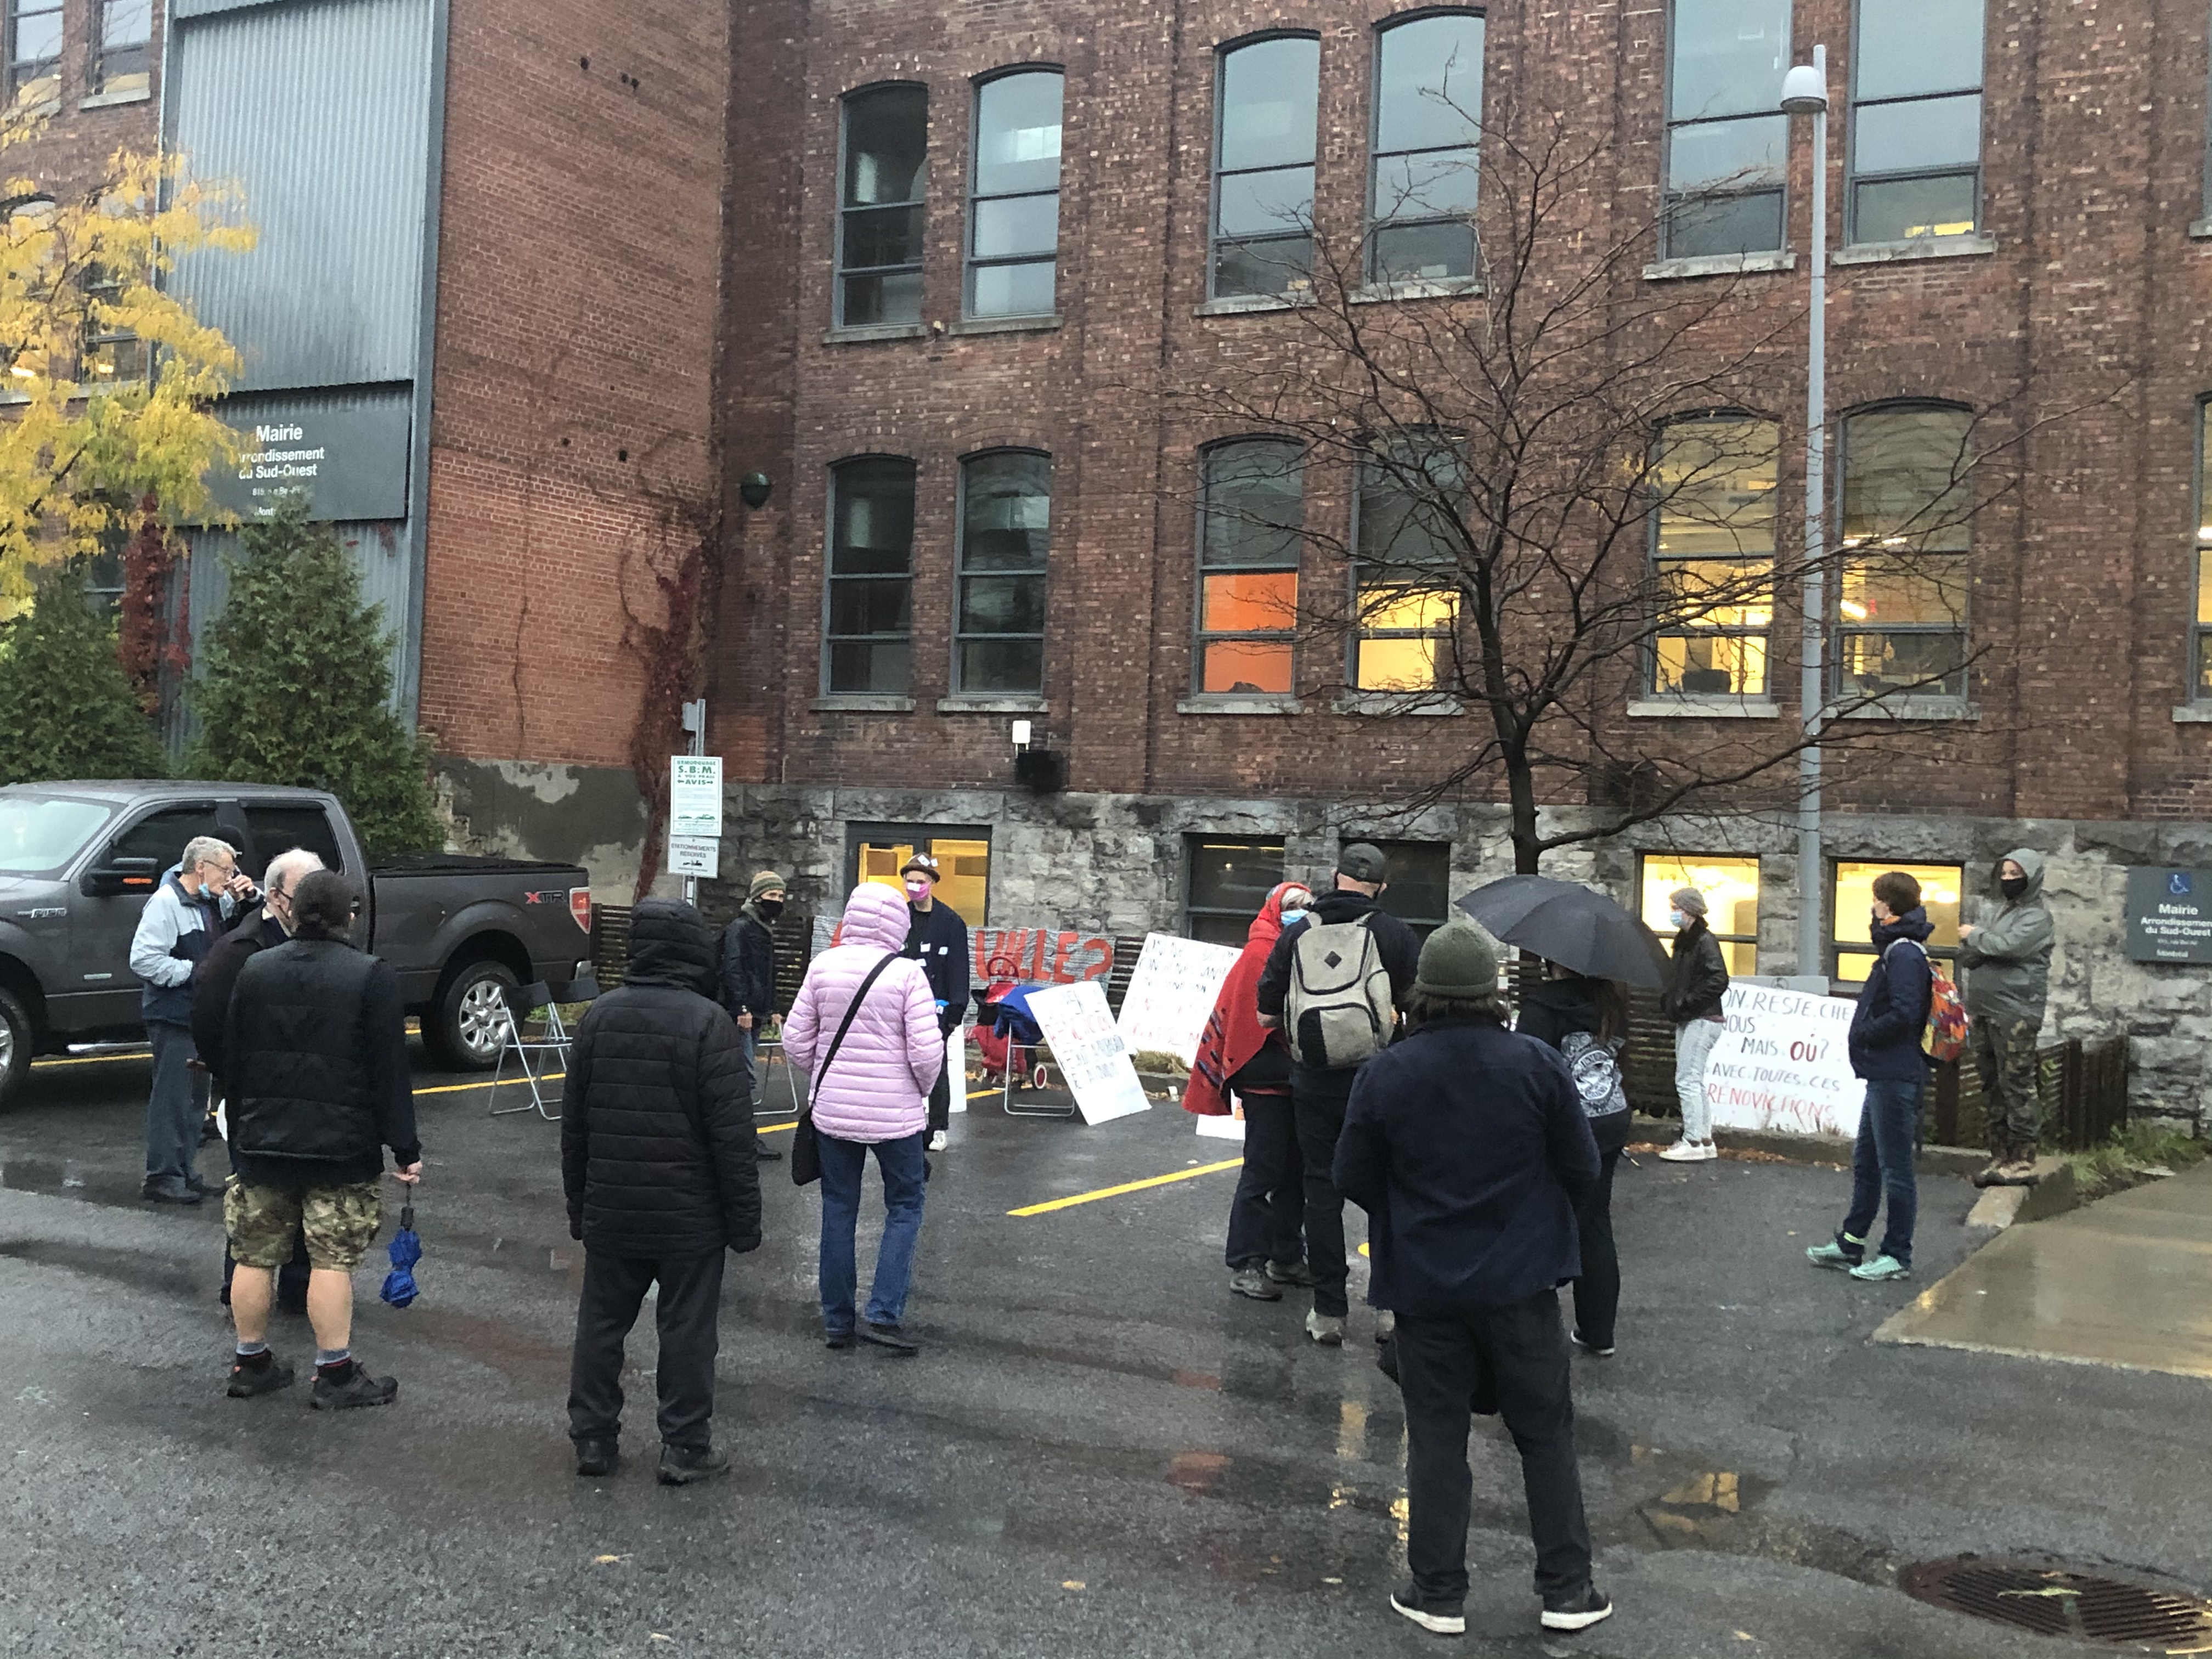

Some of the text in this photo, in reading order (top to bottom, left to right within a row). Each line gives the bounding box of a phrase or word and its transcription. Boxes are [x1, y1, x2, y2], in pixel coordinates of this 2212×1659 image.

[256, 424, 303, 442] Mairie
[239, 447, 325, 463] rrondissement
[256, 464, 317, 478] Sud-Ouest
[524, 890, 566, 904] XTR
[2158, 904, 2198, 915] Mairie
[2141, 917, 2212, 927] Arrondissemen
[2160, 927, 2211, 936] Sud-Ouest
[1752, 991, 1812, 1017] RESTE
[1820, 1003, 1851, 1021] CHE
[1741, 1036, 1779, 1056] MAIS
[1712, 1062, 1840, 1091] AVEC TOUTES CES
